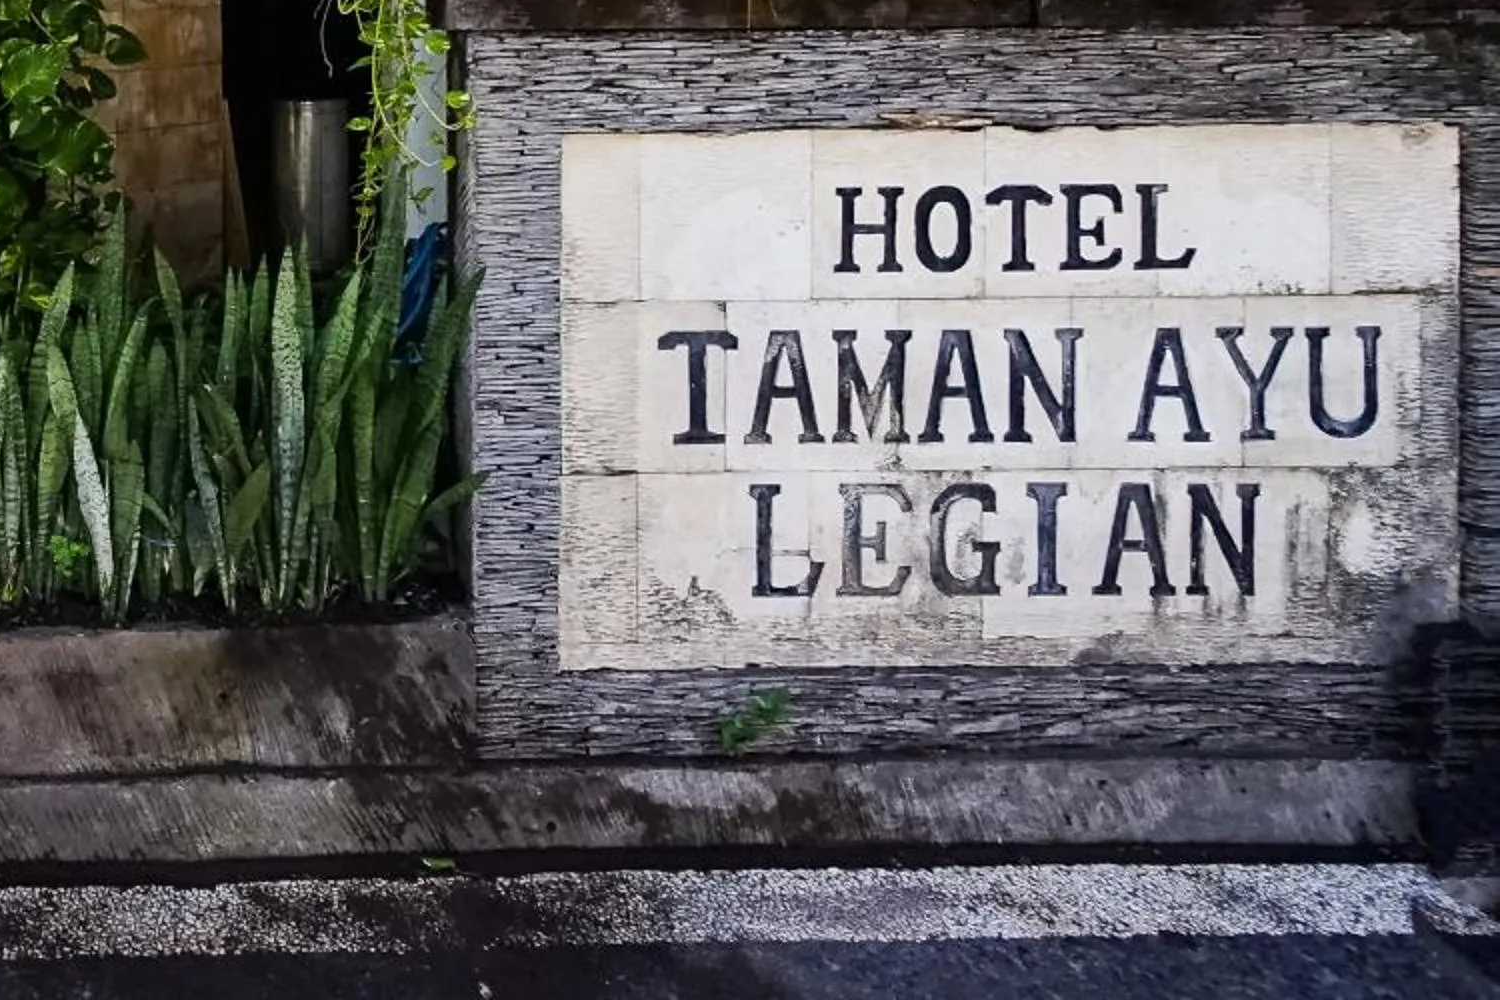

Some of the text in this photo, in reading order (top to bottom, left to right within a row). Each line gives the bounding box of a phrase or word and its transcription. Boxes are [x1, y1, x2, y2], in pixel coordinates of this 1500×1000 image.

[833, 183, 1197, 273] HOTEL
[657, 325, 1383, 445] TAMAN AYU
[748, 482, 1262, 598] LEGIAN
